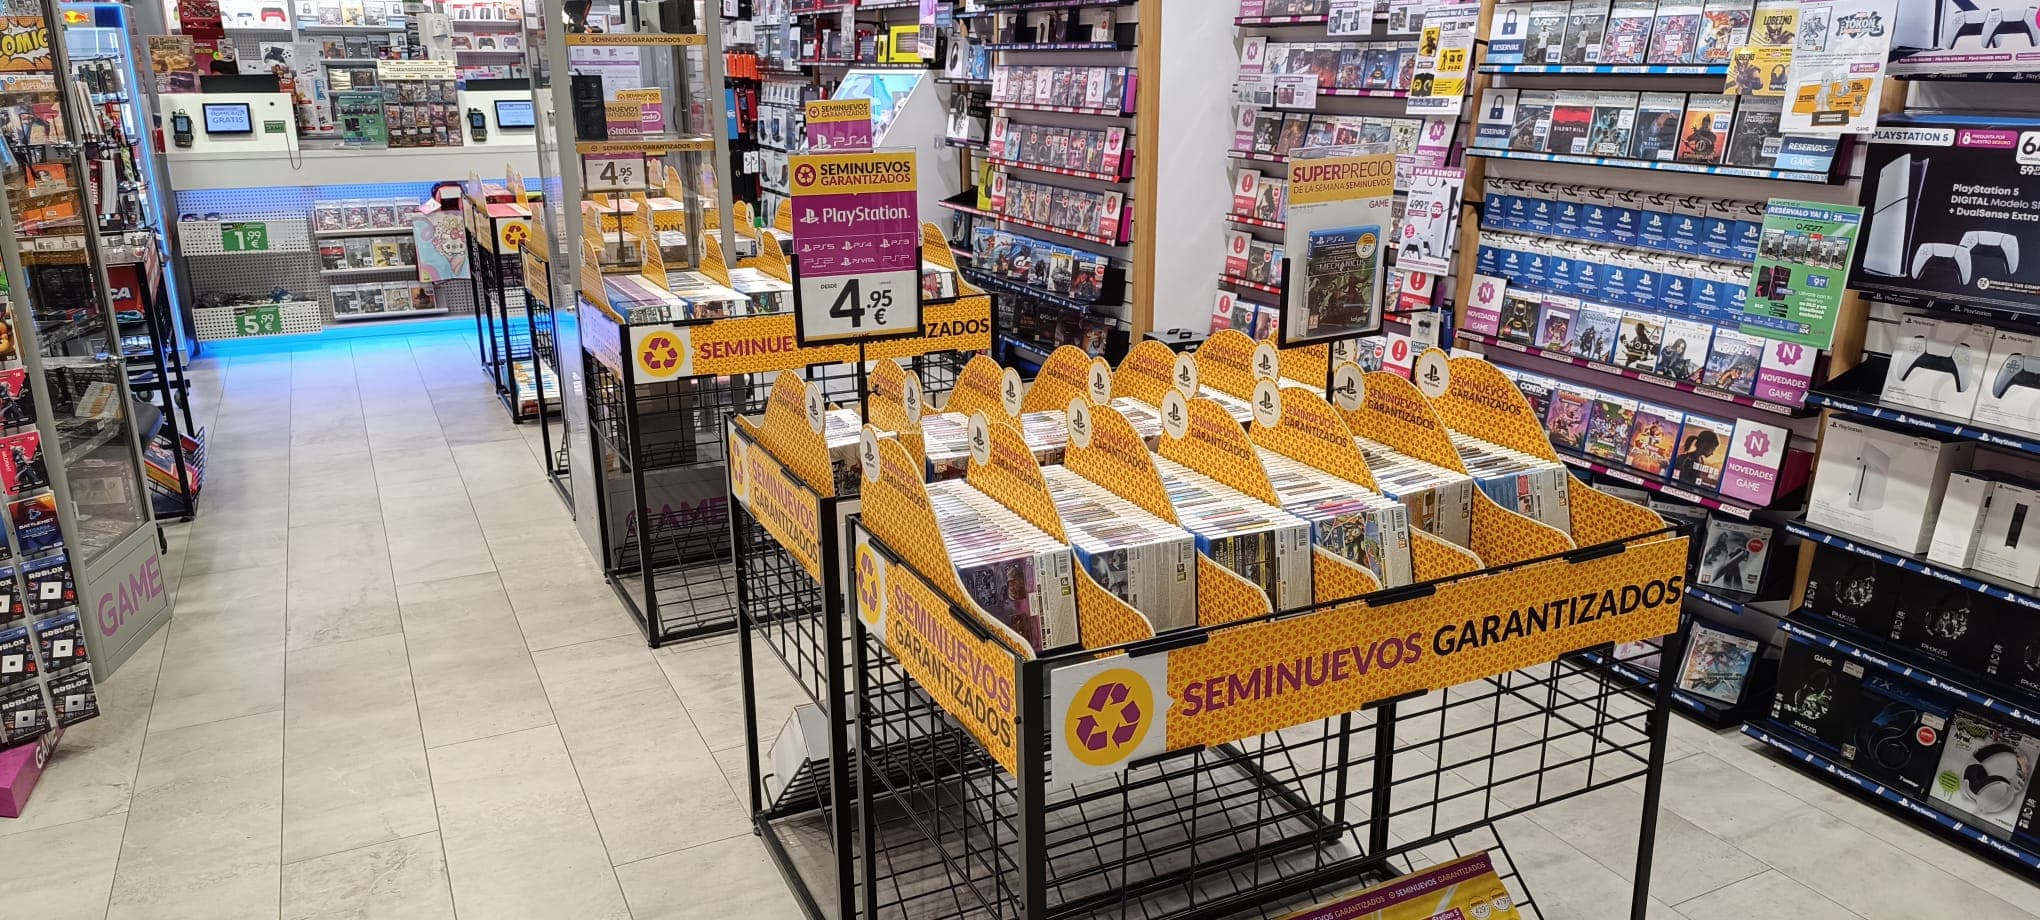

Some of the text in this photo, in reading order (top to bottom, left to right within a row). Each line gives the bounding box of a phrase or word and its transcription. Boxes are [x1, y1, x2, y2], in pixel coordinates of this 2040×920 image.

[0, 28, 48, 56] OMIC
[821, 102, 868, 112] SEMINUEVOS
[821, 108, 868, 118] GARANTIZADOS
[1480, 127, 1506, 136] RESERVAS
[1872, 131, 1949, 142] PLAYSTATION 5
[833, 135, 869, 146] PS4
[1788, 141, 1830, 153] RESERVAS
[820, 160, 911, 176] SEMINUEVOS
[1790, 156, 1816, 167] GAME
[820, 172, 911, 186] GARANTIZADOS
[1293, 160, 1393, 183] SUPERPRECIO
[1415, 168, 1462, 178] PLAN RENOVE
[1293, 178, 1391, 194] DE LA SEMANA SEMINUEVOS
[1952, 183, 2020, 197] PlayStation 5
[1368, 199, 1389, 209] GAME
[1951, 195, 2029, 209] DIGITAL Modelo
[823, 204, 911, 227] PlayStation
[1810, 210, 1821, 218] YA!
[1956, 207, 2010, 219] DualSense
[2011, 211, 2039, 222] Extra
[813, 243, 835, 251] PS5
[1481, 290, 1491, 299] N
[873, 307, 888, 326] €
[1467, 309, 1498, 322] NOVEDADES
[1471, 322, 1489, 332] GAME
[699, 334, 798, 361] SEMINUE
[1210, 342, 1250, 361] SEMINUEVOS
[1783, 344, 1796, 359] N
[1202, 350, 1250, 373] GARANTIZADOS
[1450, 374, 1511, 402] SEMINUEVOS
[1519, 381, 1548, 395] CONTROL
[1761, 372, 1807, 389] NOVEDADES
[1368, 386, 1424, 413] SEMINUEVOS
[1450, 387, 1522, 417] GARANTIZADOS
[1768, 388, 1793, 401] GAME
[1755, 401, 1791, 414] NOVEDADES
[1832, 400, 1858, 412] PlayStation
[1285, 405, 1336, 432] SEMINUEVOS
[1366, 400, 1435, 431] GARANTIZADOS
[1908, 417, 1937, 429] PlayStation
[1191, 414, 1240, 442] SEMINUEVOS
[1283, 415, 1348, 449] GARANTIZADOS
[1093, 424, 1138, 452] SEMINUEVOS
[1191, 427, 1250, 461] GARANTIZADOS
[1750, 437, 1763, 451] N
[1991, 435, 2023, 448] PlayStation
[1093, 437, 1149, 473] GARANTIZADOS
[1728, 462, 1774, 481] NOVEDADES
[1736, 478, 1761, 492] GAME
[751, 460, 815, 536] SEMINUEVOS
[754, 486, 818, 564] GARANTIZADOS
[1857, 546, 1883, 559] PlayStation
[28, 565, 65, 580] ROBLOX
[1933, 571, 1962, 584] PlayStation
[98, 554, 163, 637] GAME
[41, 623, 75, 639] ROBLOX
[1792, 626, 1817, 640] PlayStation
[894, 584, 1012, 714] SEMINUEVOS
[1181, 574, 1684, 718] SEMINUEVOS GARANTIZADOS
[1814, 654, 1833, 667] GAME
[1862, 653, 1889, 668] PlayStation
[53, 678, 88, 695] ROBLOX
[894, 619, 1012, 749] GARANTIZADOS
[1939, 682, 1968, 698] PlayStation
[2, 693, 39, 711] ROBLOX
[1769, 738, 1793, 753] PlayStation
[1836, 769, 1862, 785] PlayStation
[1910, 802, 1937, 820] PlayStation
[1990, 840, 2020, 858] PlayStation
[1395, 861, 1486, 898] SEMINUEVOS GARANTIZADOS
[1334, 895, 1385, 919] GARANTIZADOS
